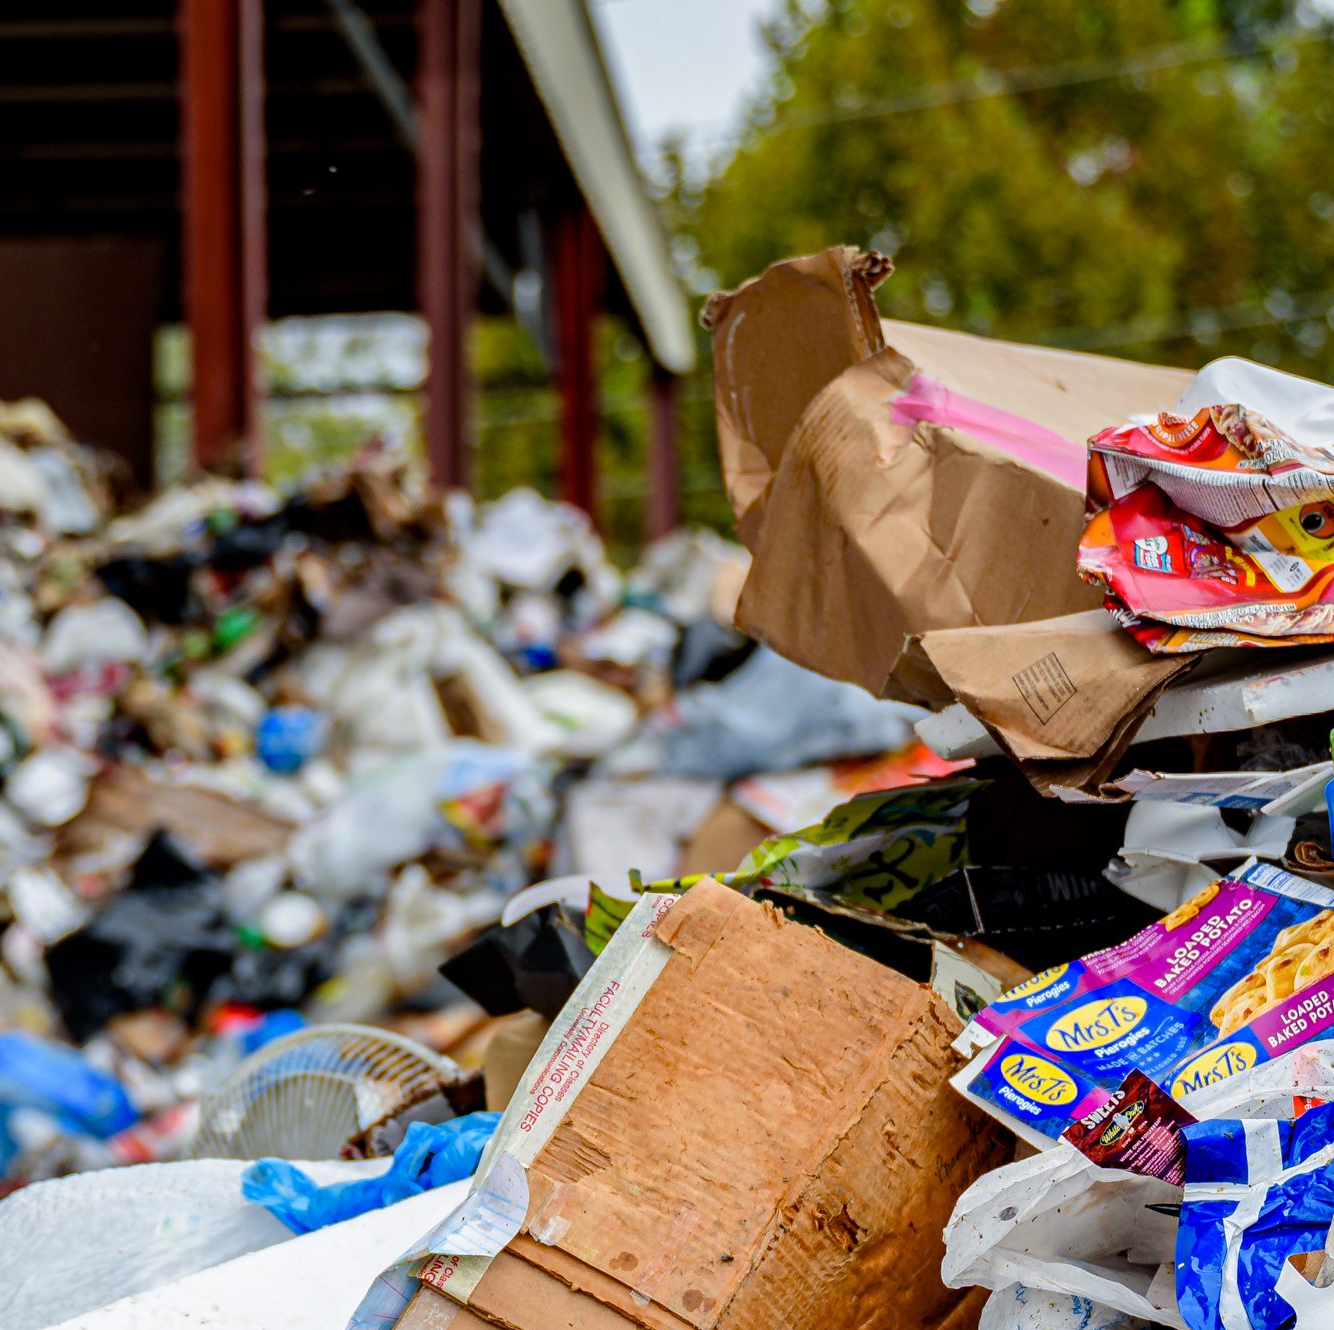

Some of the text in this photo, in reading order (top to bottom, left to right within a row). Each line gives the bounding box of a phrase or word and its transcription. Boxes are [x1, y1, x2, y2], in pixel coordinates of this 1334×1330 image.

[1154, 950, 1201, 988] BAKED
[1200, 899, 1253, 948] POTATO
[1166, 915, 1221, 965] LOADED
[1025, 981, 1070, 1007] Pierogies
[1281, 990, 1329, 1026] LOADED
[530, 1007, 589, 1095] University Communications
[582, 1022, 610, 1059] Directory
[1094, 1027, 1150, 1058] Pierogies
[1097, 1057, 1128, 1071] MADE
[1137, 1022, 1184, 1055] BATCHES
[1267, 1016, 1308, 1049] BAKED
[555, 1070, 579, 1102] Classes
[998, 1086, 1042, 1116] Pierogies
[520, 1086, 554, 1133] COPIES
[1081, 1090, 1126, 1130] SWEETS
